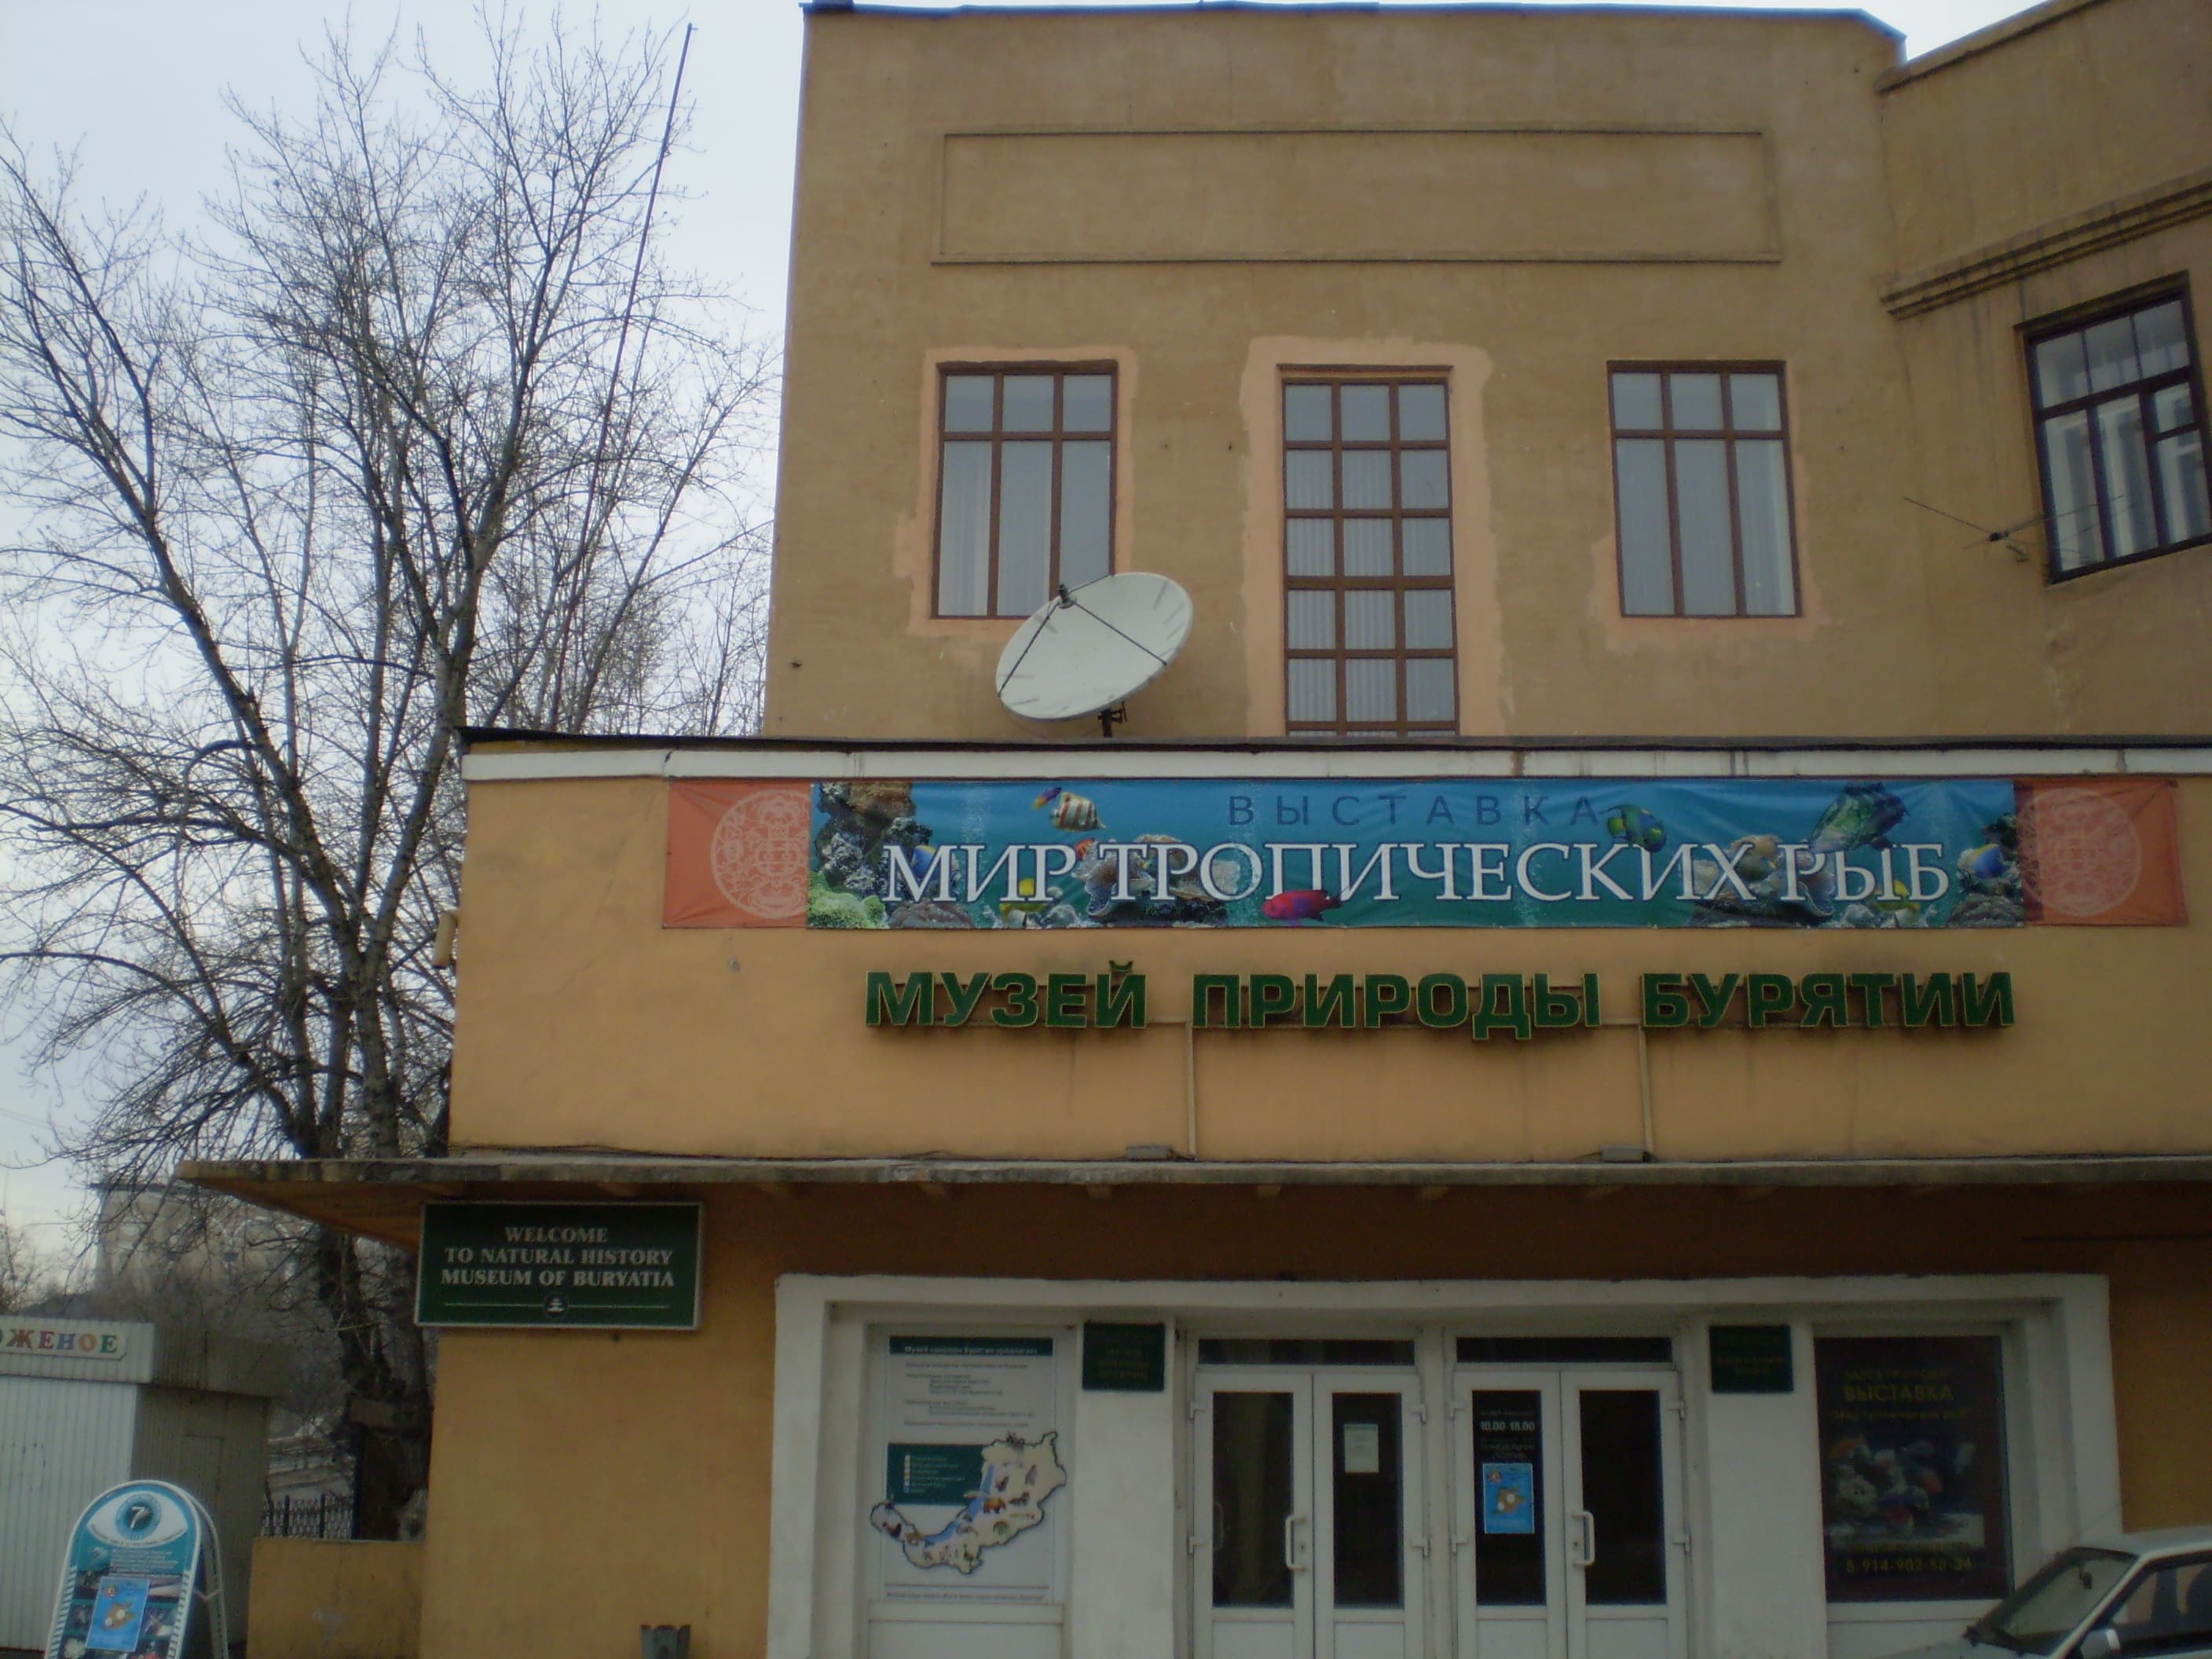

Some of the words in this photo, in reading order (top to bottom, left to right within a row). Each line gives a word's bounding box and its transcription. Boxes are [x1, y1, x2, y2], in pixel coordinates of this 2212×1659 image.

[1229, 794, 1599, 826] ВЫСТАВКА
[882, 843, 1077, 903] МИР
[1101, 843, 1756, 903] ТРОПИЧЕСКИХ
[1781, 844, 1951, 903] РЫБ
[865, 960, 1148, 1028] МУЗЕЙ
[1192, 972, 1602, 1041] ПРИРОДЫ
[1640, 972, 2015, 1029] БУРЯТИИ
[505, 1228, 608, 1243] WELCOME
[445, 1248, 472, 1263] TO
[481, 1249, 573, 1264] NATURAL
[581, 1250, 673, 1265] HISTORY
[441, 1269, 532, 1286] MUSEUM
[539, 1270, 565, 1286] OF
[573, 1271, 674, 1287] BURYATIA
[0, 1328, 118, 1353] ЖЕНОЕ
